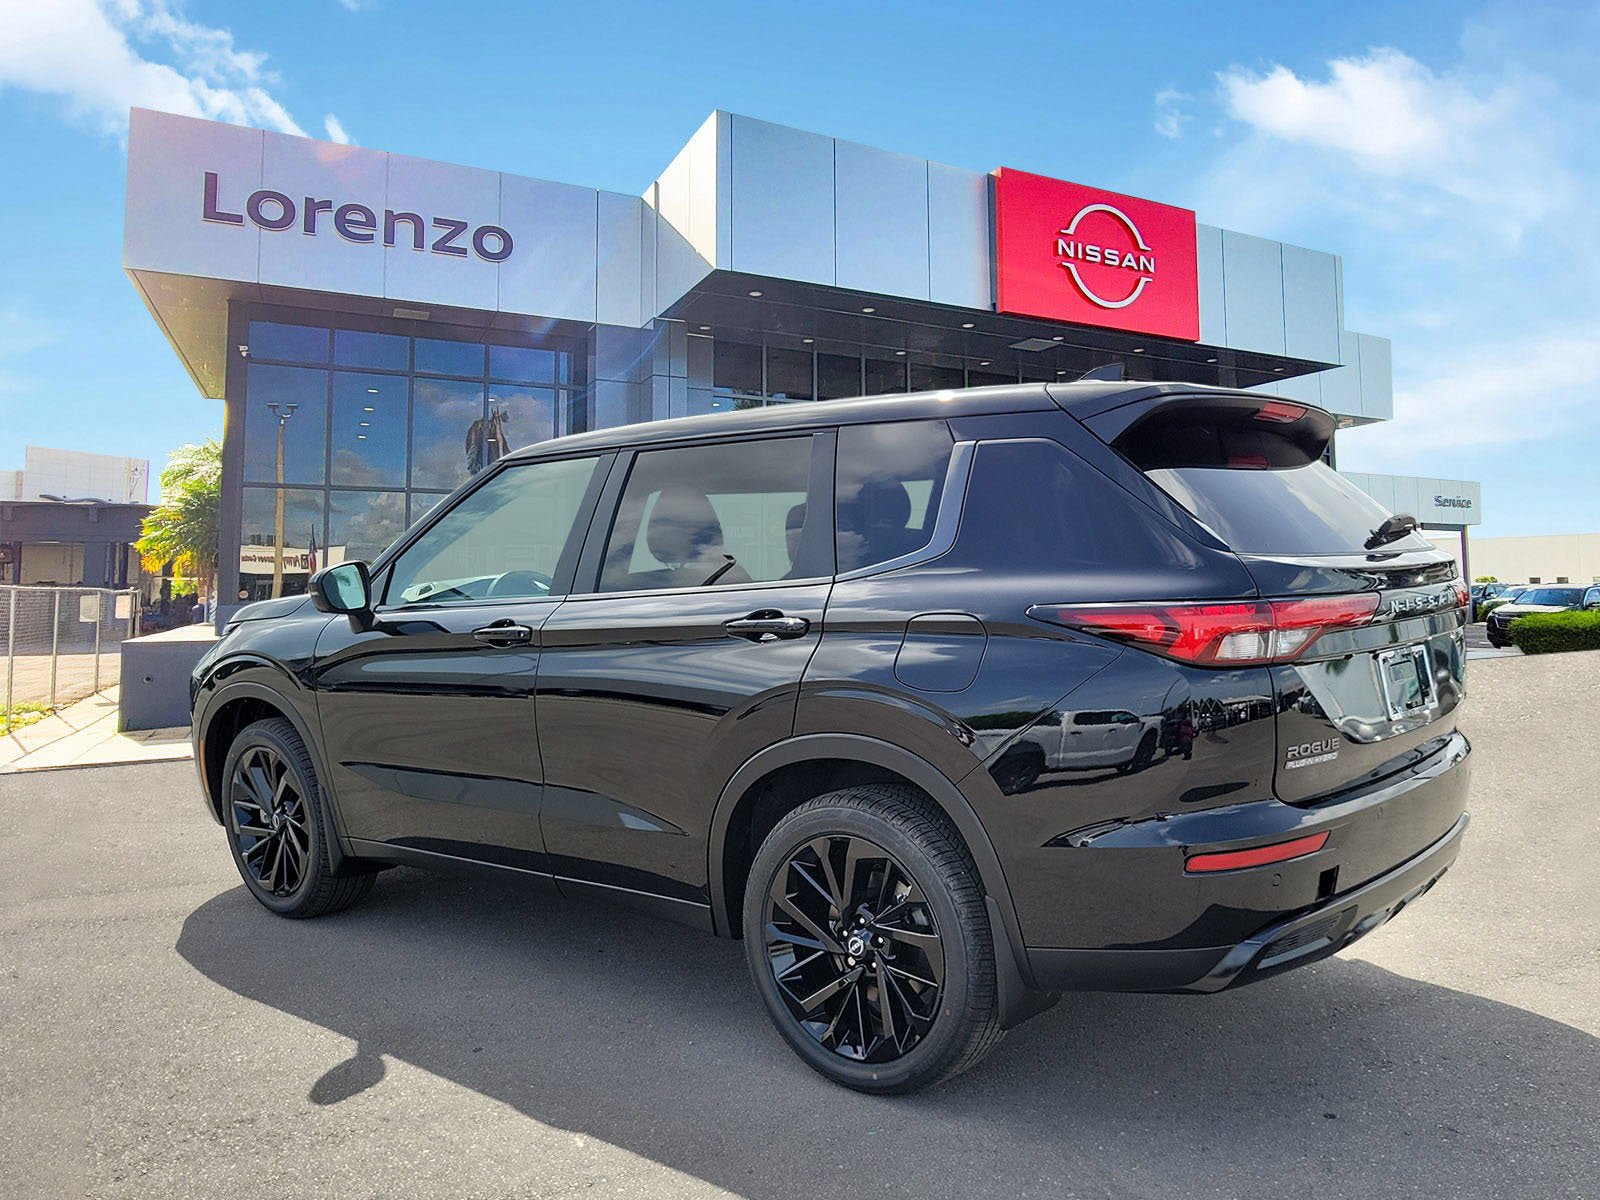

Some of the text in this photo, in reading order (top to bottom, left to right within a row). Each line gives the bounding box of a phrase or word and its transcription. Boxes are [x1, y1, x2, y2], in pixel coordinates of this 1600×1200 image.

[202, 171, 514, 262] Lorenzo
[1057, 238, 1155, 273] NISSAN
[1434, 495, 1472, 508] Service
[1286, 737, 1340, 758] ROGUE
